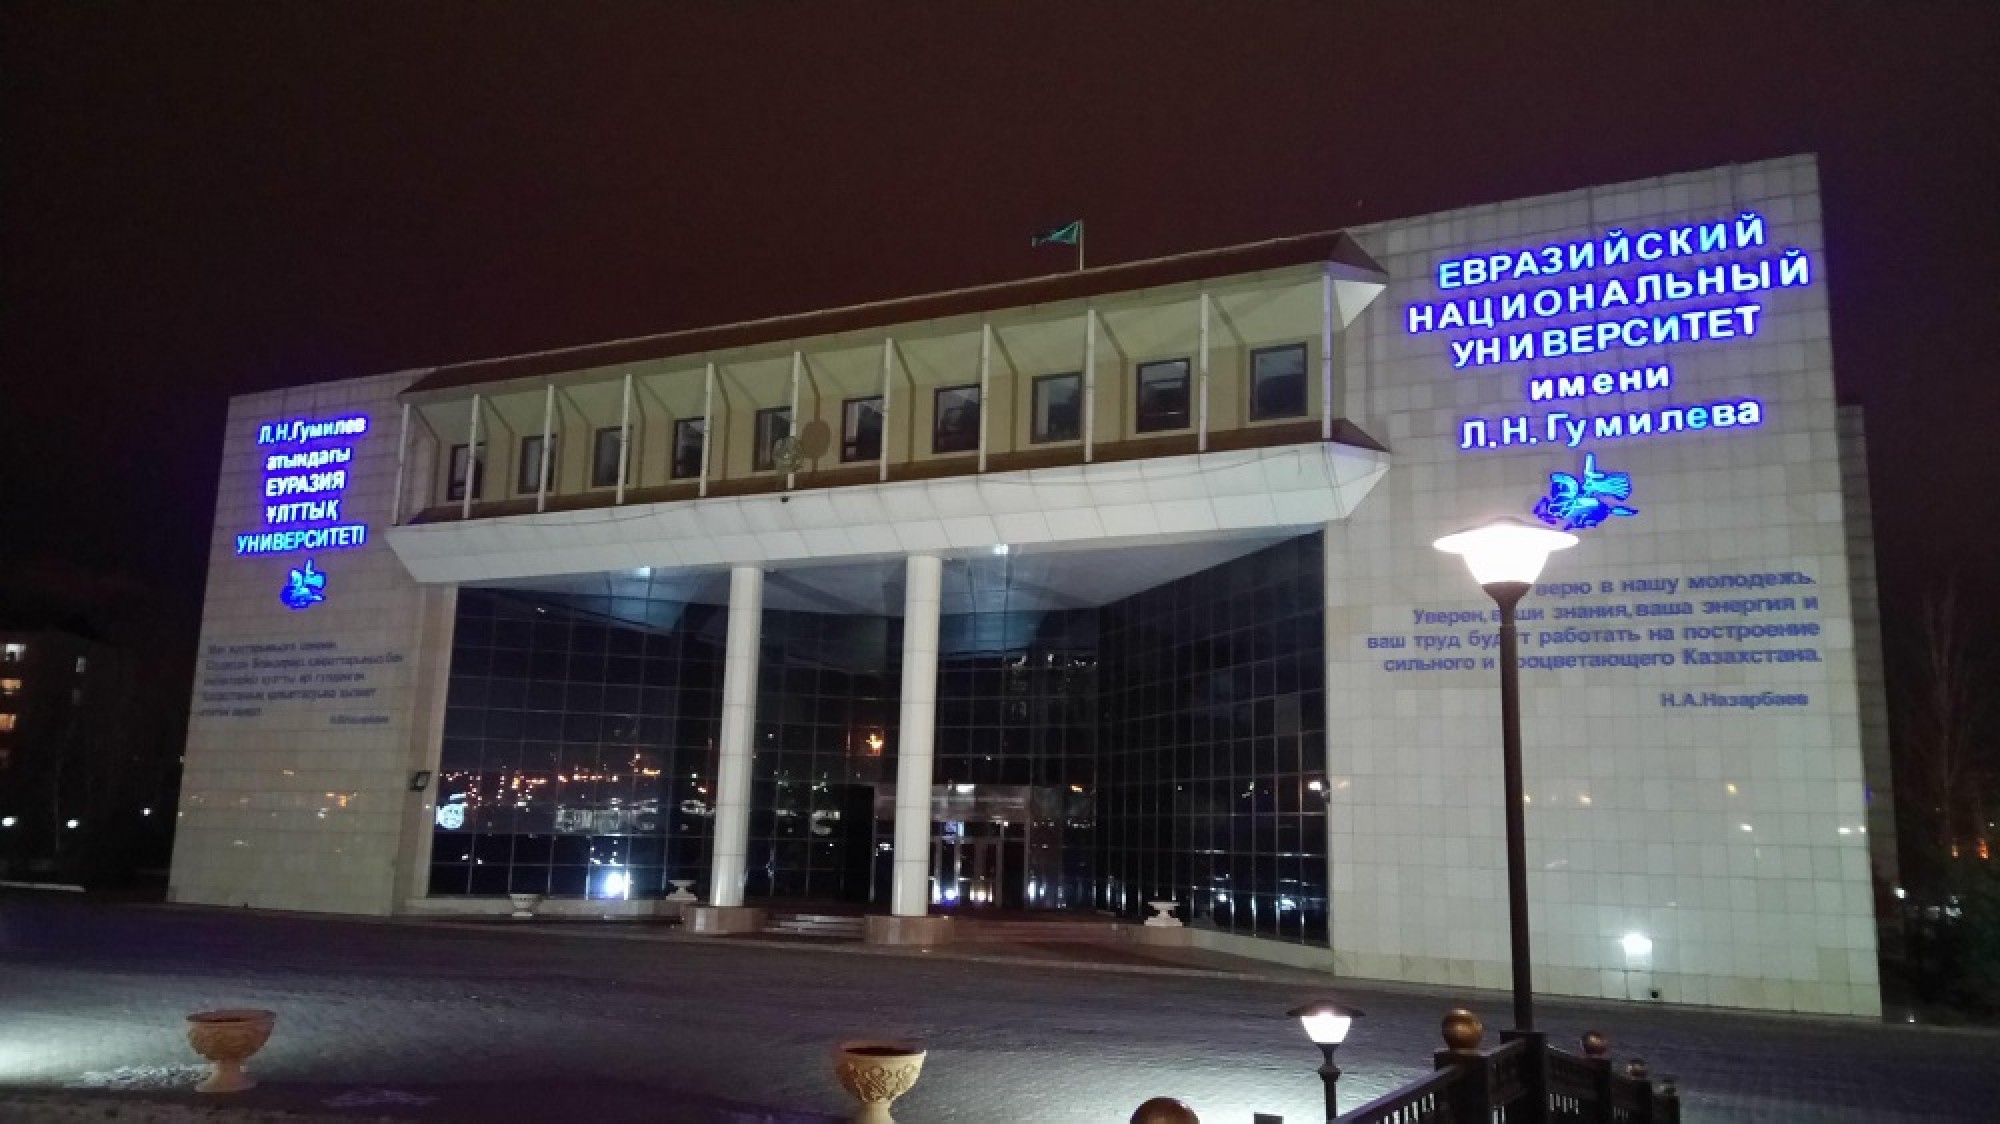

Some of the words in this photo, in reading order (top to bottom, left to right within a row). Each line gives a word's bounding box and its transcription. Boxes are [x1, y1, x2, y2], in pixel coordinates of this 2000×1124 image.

[1440, 214, 1764, 289] ЕВРАЗИЙСКИЙ
[1409, 250, 1810, 333] НАЦИОНАЛЬНЫЙ
[1452, 305, 1761, 368] УНИВЕРСИТЕТ
[1531, 365, 1670, 401] имени
[266, 470, 345, 497] ЕУРАЗИЯ
[237, 525, 366, 554] УНИВЕРСИТЕТІ
[1601, 580, 1614, 593] в
[1621, 577, 1679, 595] нашу
[1413, 609, 1487, 626] Уверен,
[1491, 608, 1544, 621] вши
[1553, 604, 1632, 620] знания,
[1635, 602, 1693, 616] ваша
[1803, 596, 1818, 610] и
[1367, 635, 1406, 649] ваш
[1413, 635, 1461, 652] труд
[1468, 629, 1531, 651] будт
[1539, 627, 1641, 647] работать
[1649, 627, 1674, 641] на
[1383, 658, 1475, 672] сильного
[1481, 658, 1495, 669] и
[1507, 654, 1675, 669] оцветающего
